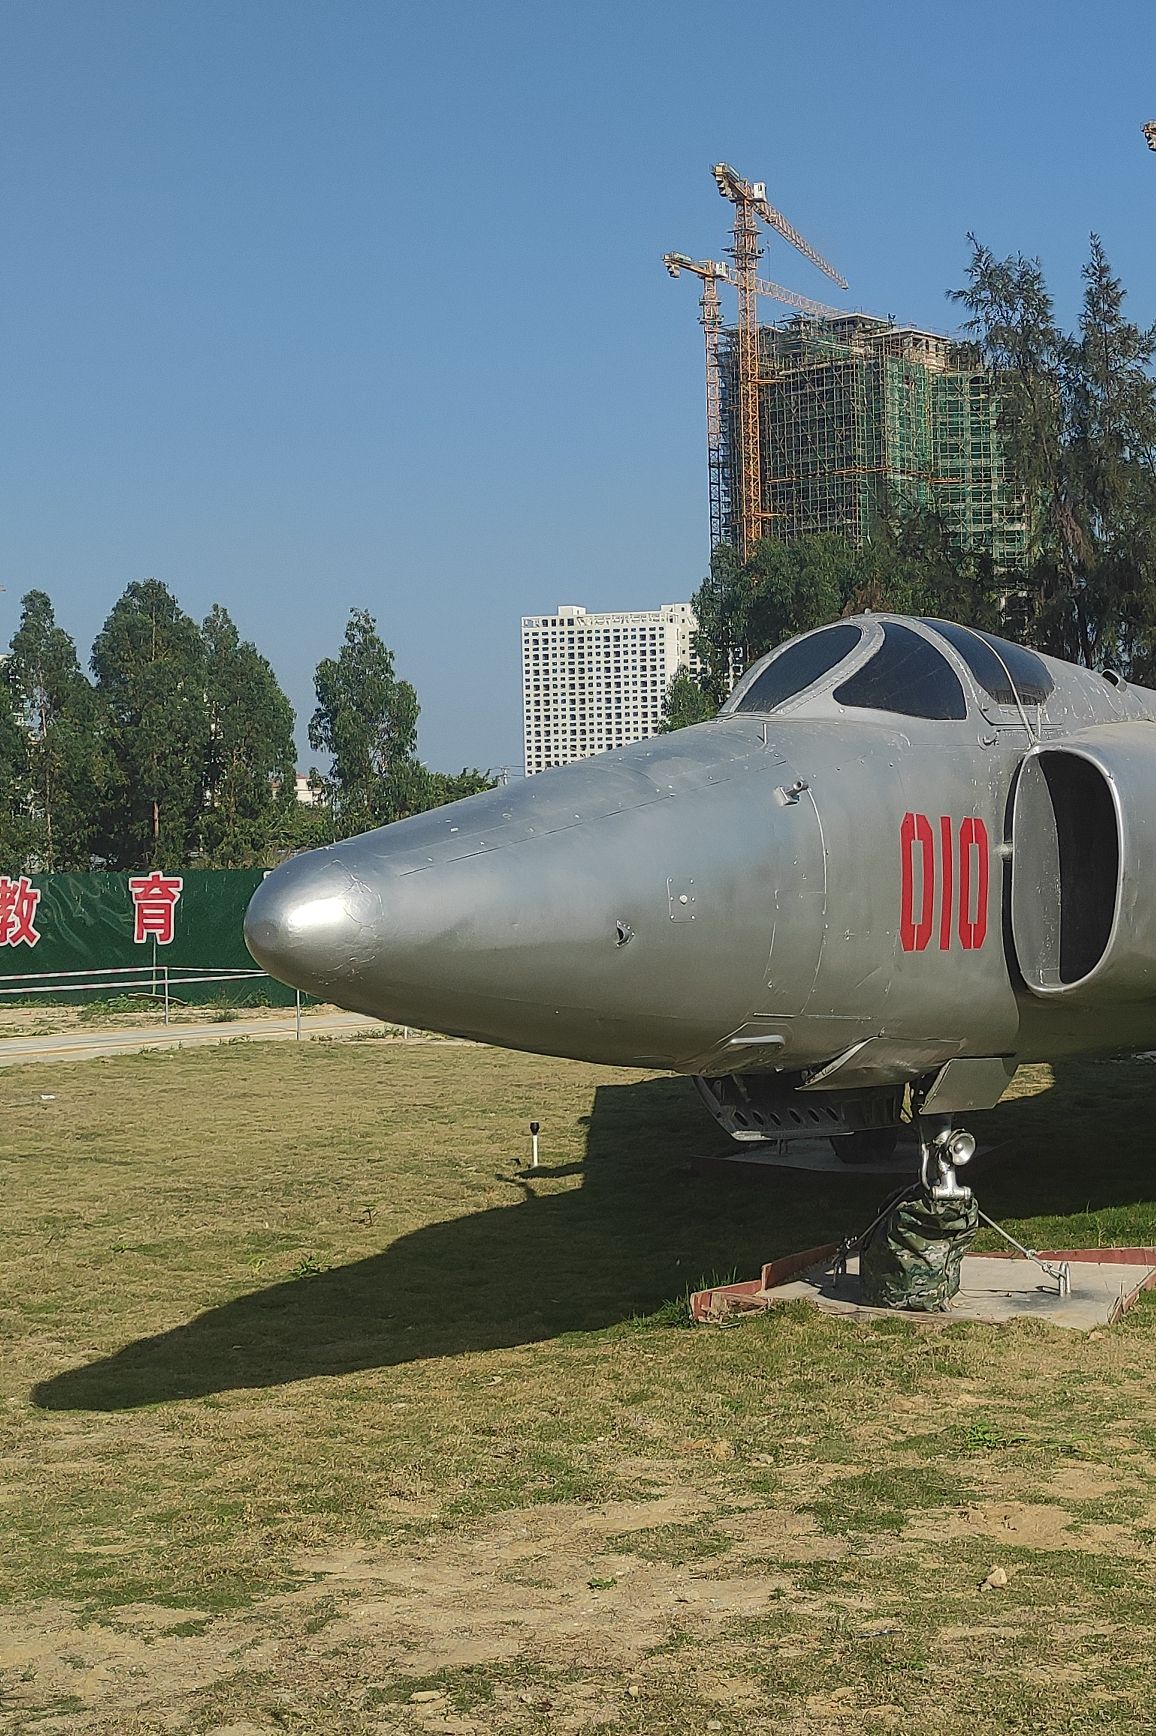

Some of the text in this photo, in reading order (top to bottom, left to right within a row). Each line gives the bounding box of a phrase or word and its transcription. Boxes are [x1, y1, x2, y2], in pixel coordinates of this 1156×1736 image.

[0, 870, 184, 948] 教 育
[900, 811, 989, 952] 010
